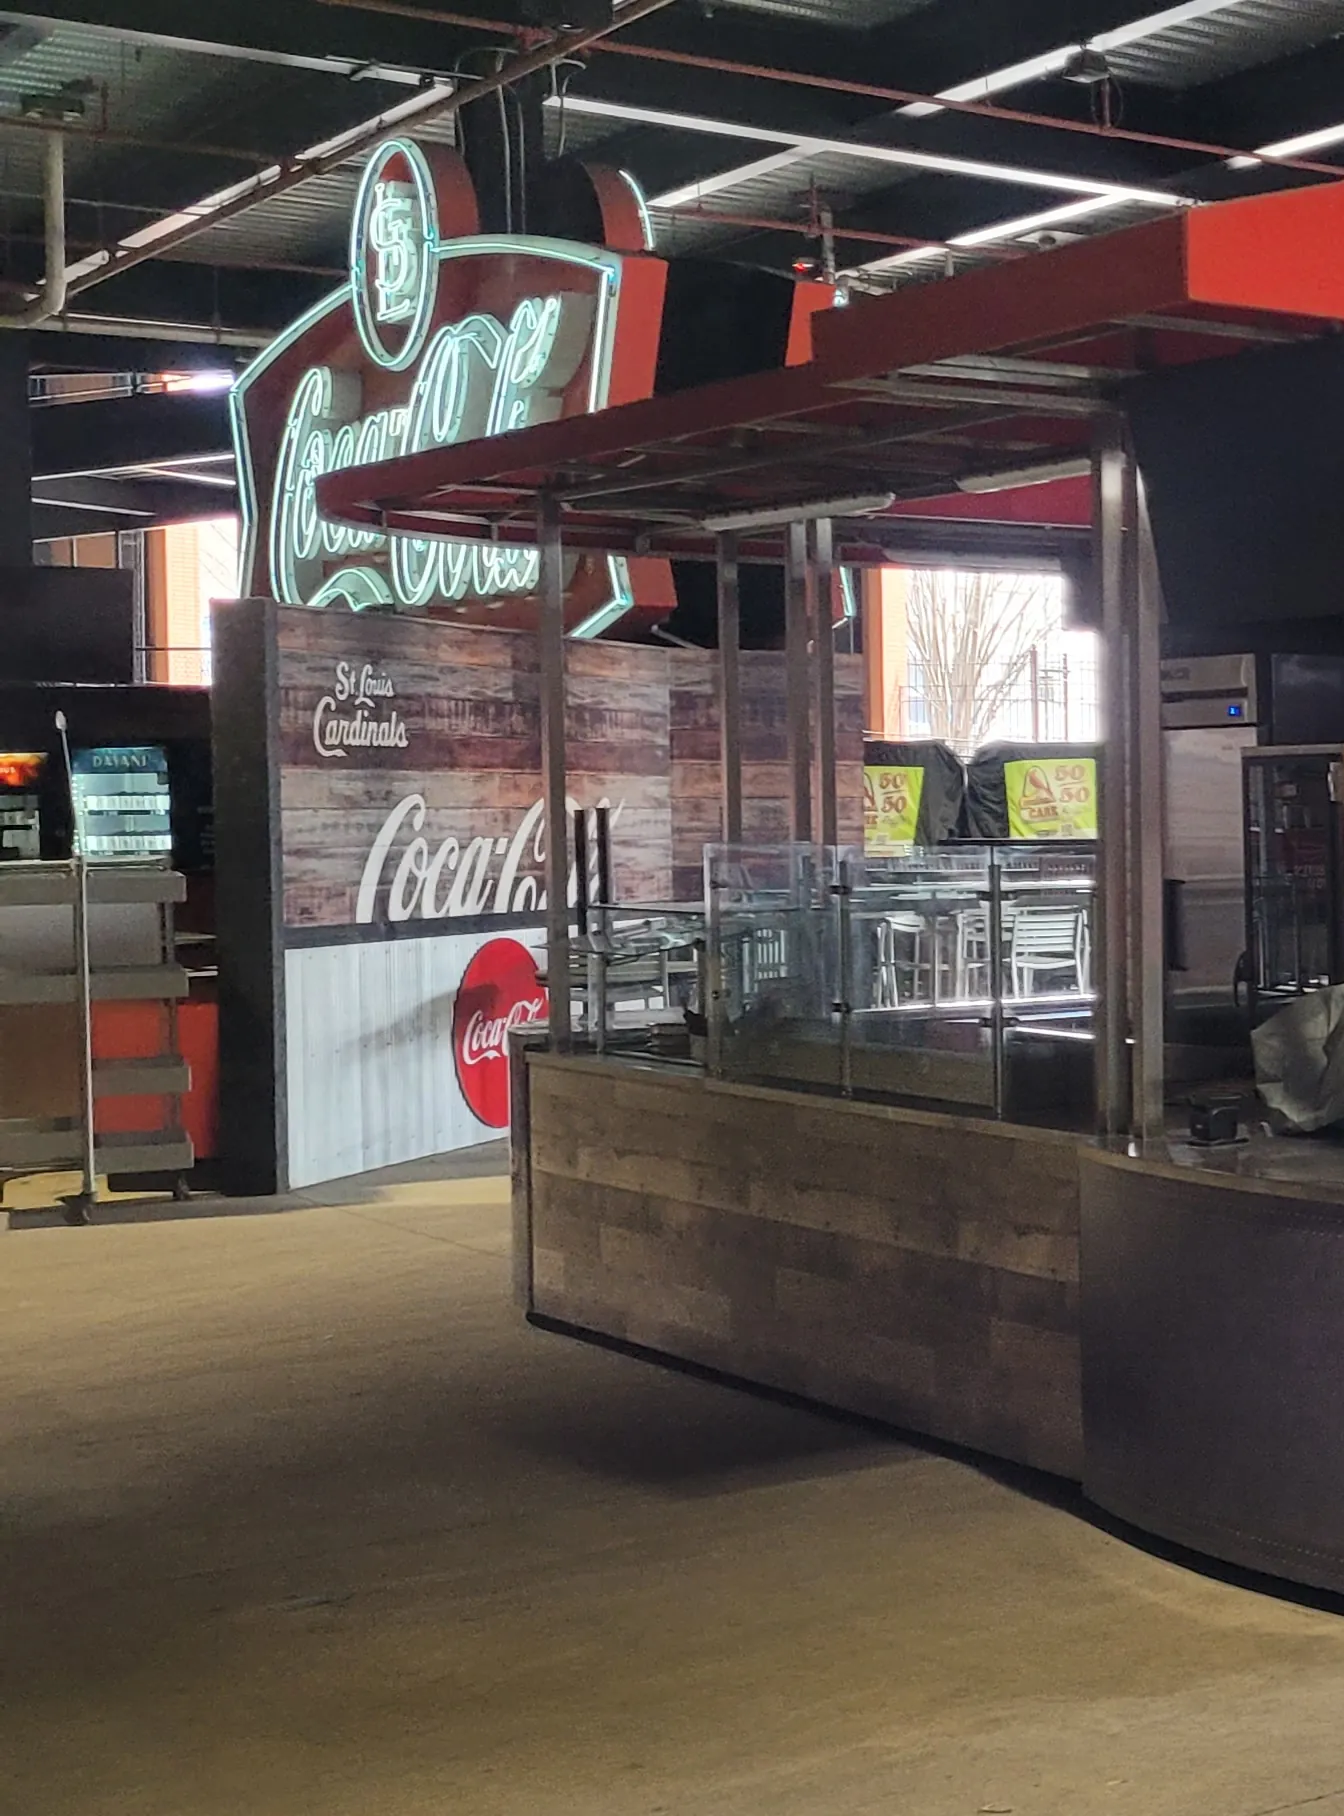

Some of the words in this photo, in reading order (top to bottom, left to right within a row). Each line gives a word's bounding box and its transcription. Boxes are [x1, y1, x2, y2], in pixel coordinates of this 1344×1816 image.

[354, 674, 395, 708] Louis
[313, 696, 409, 757] Cardinals
[879, 771, 906, 789] 50
[1055, 764, 1086, 781] 50
[1059, 786, 1090, 802] 50
[881, 796, 907, 814] 50
